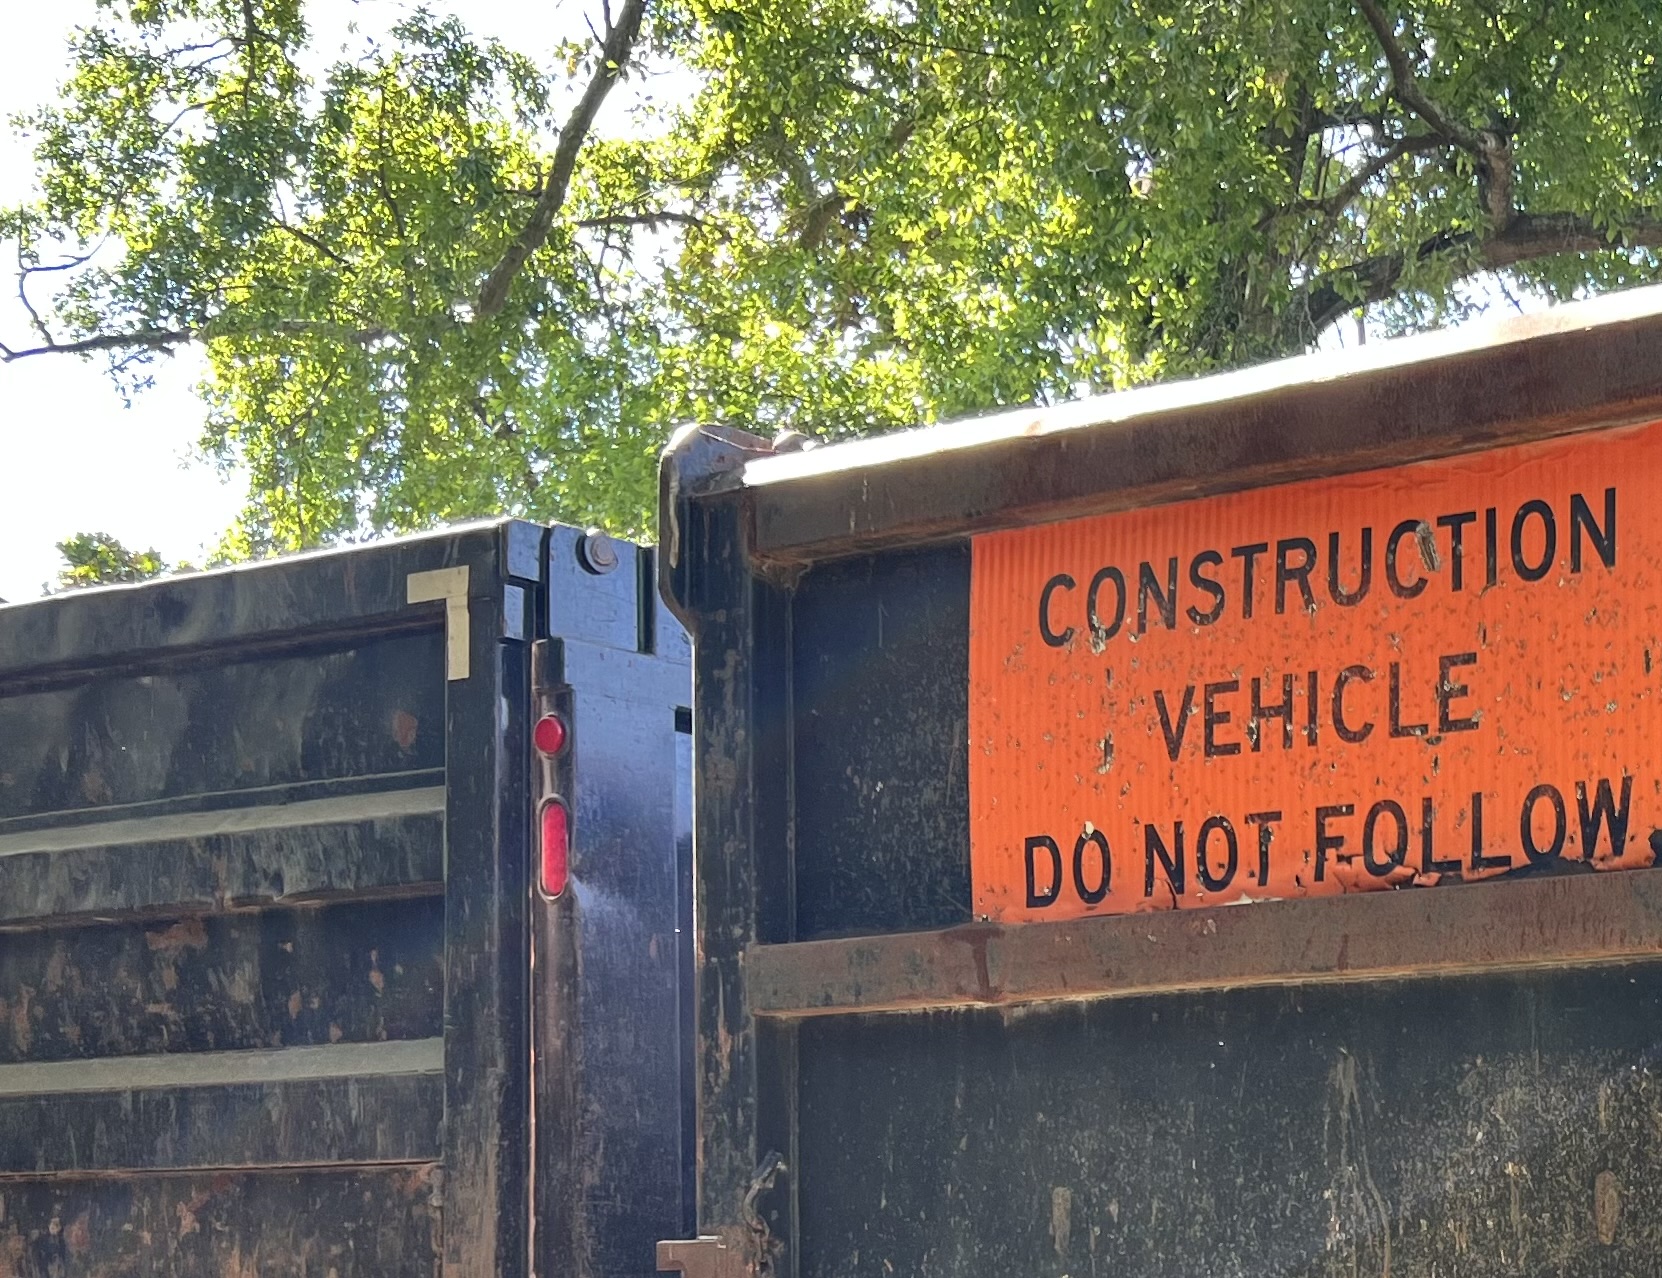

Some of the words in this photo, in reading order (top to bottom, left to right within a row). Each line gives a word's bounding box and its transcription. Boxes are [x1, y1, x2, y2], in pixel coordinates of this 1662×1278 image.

[1038, 487, 1618, 647] CONSTRUCTION
[1154, 651, 1480, 762] VEHICLE
[1024, 829, 1112, 908] DO
[1145, 810, 1282, 897] NOT
[1314, 775, 1633, 883] FOLLOW
